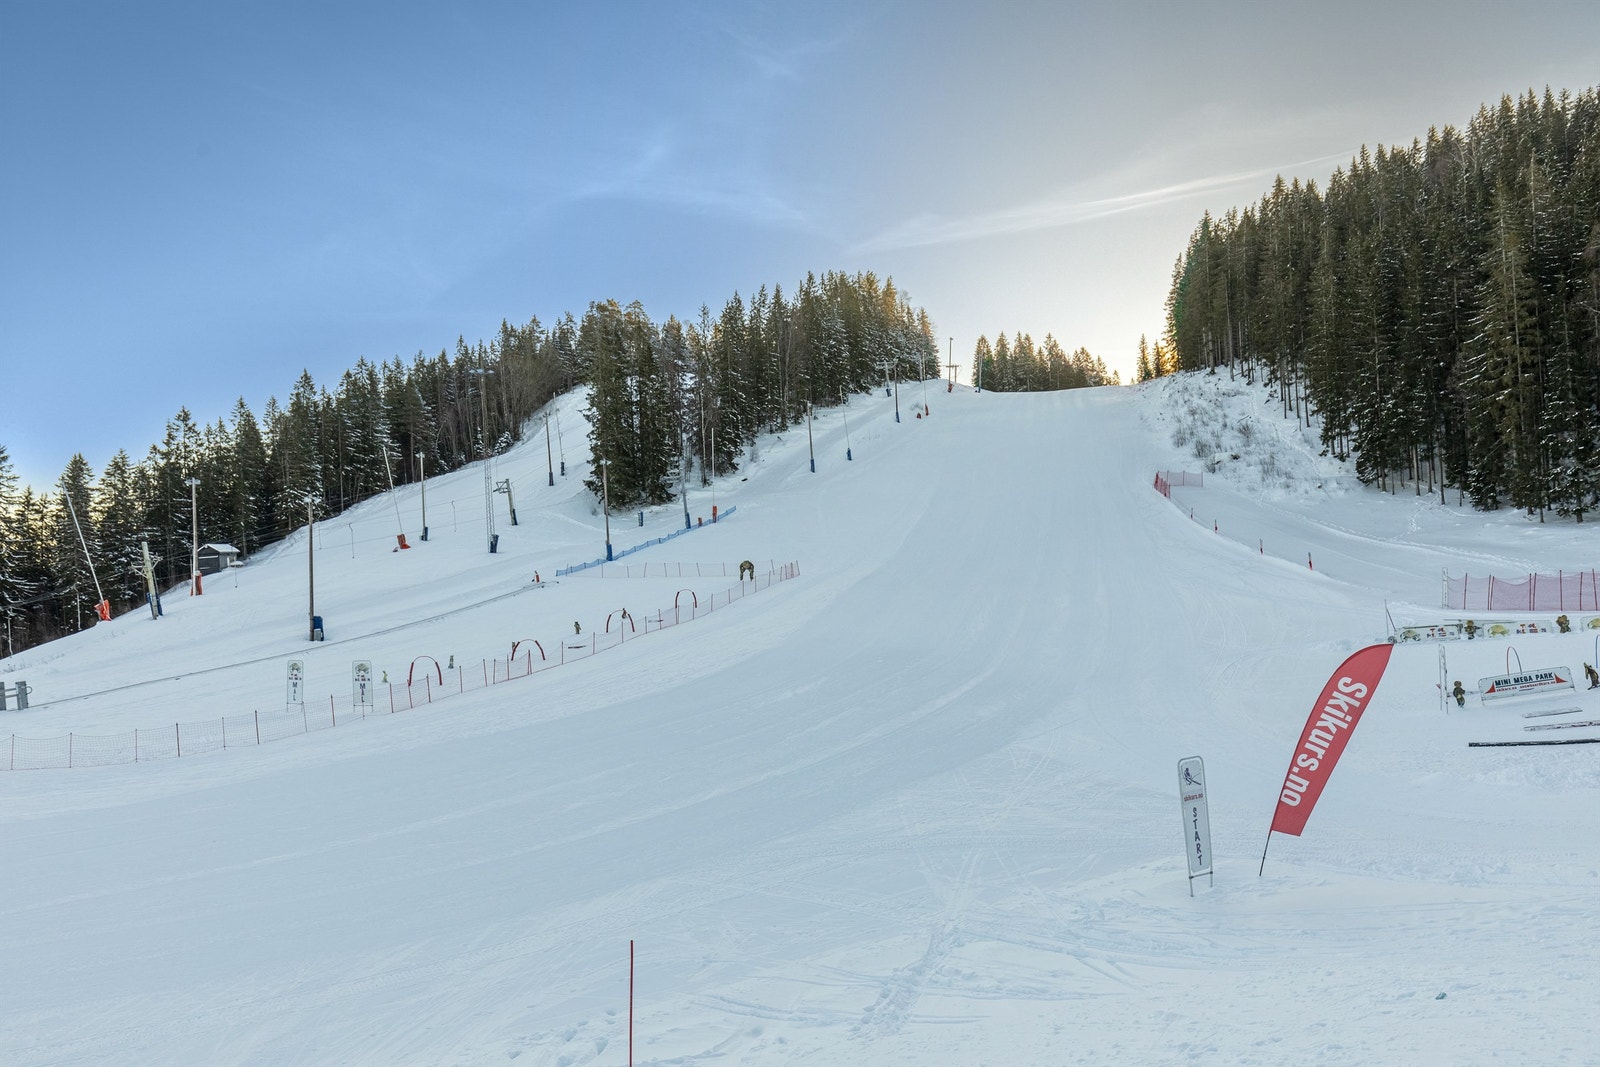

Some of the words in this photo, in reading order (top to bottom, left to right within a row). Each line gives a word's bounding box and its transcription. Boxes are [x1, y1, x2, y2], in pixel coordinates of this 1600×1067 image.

[1494, 678, 1511, 686] MINI
[1514, 675, 1533, 684] MEGA
[1535, 672, 1554, 681] PARK
[1192, 806, 1203, 866] START
